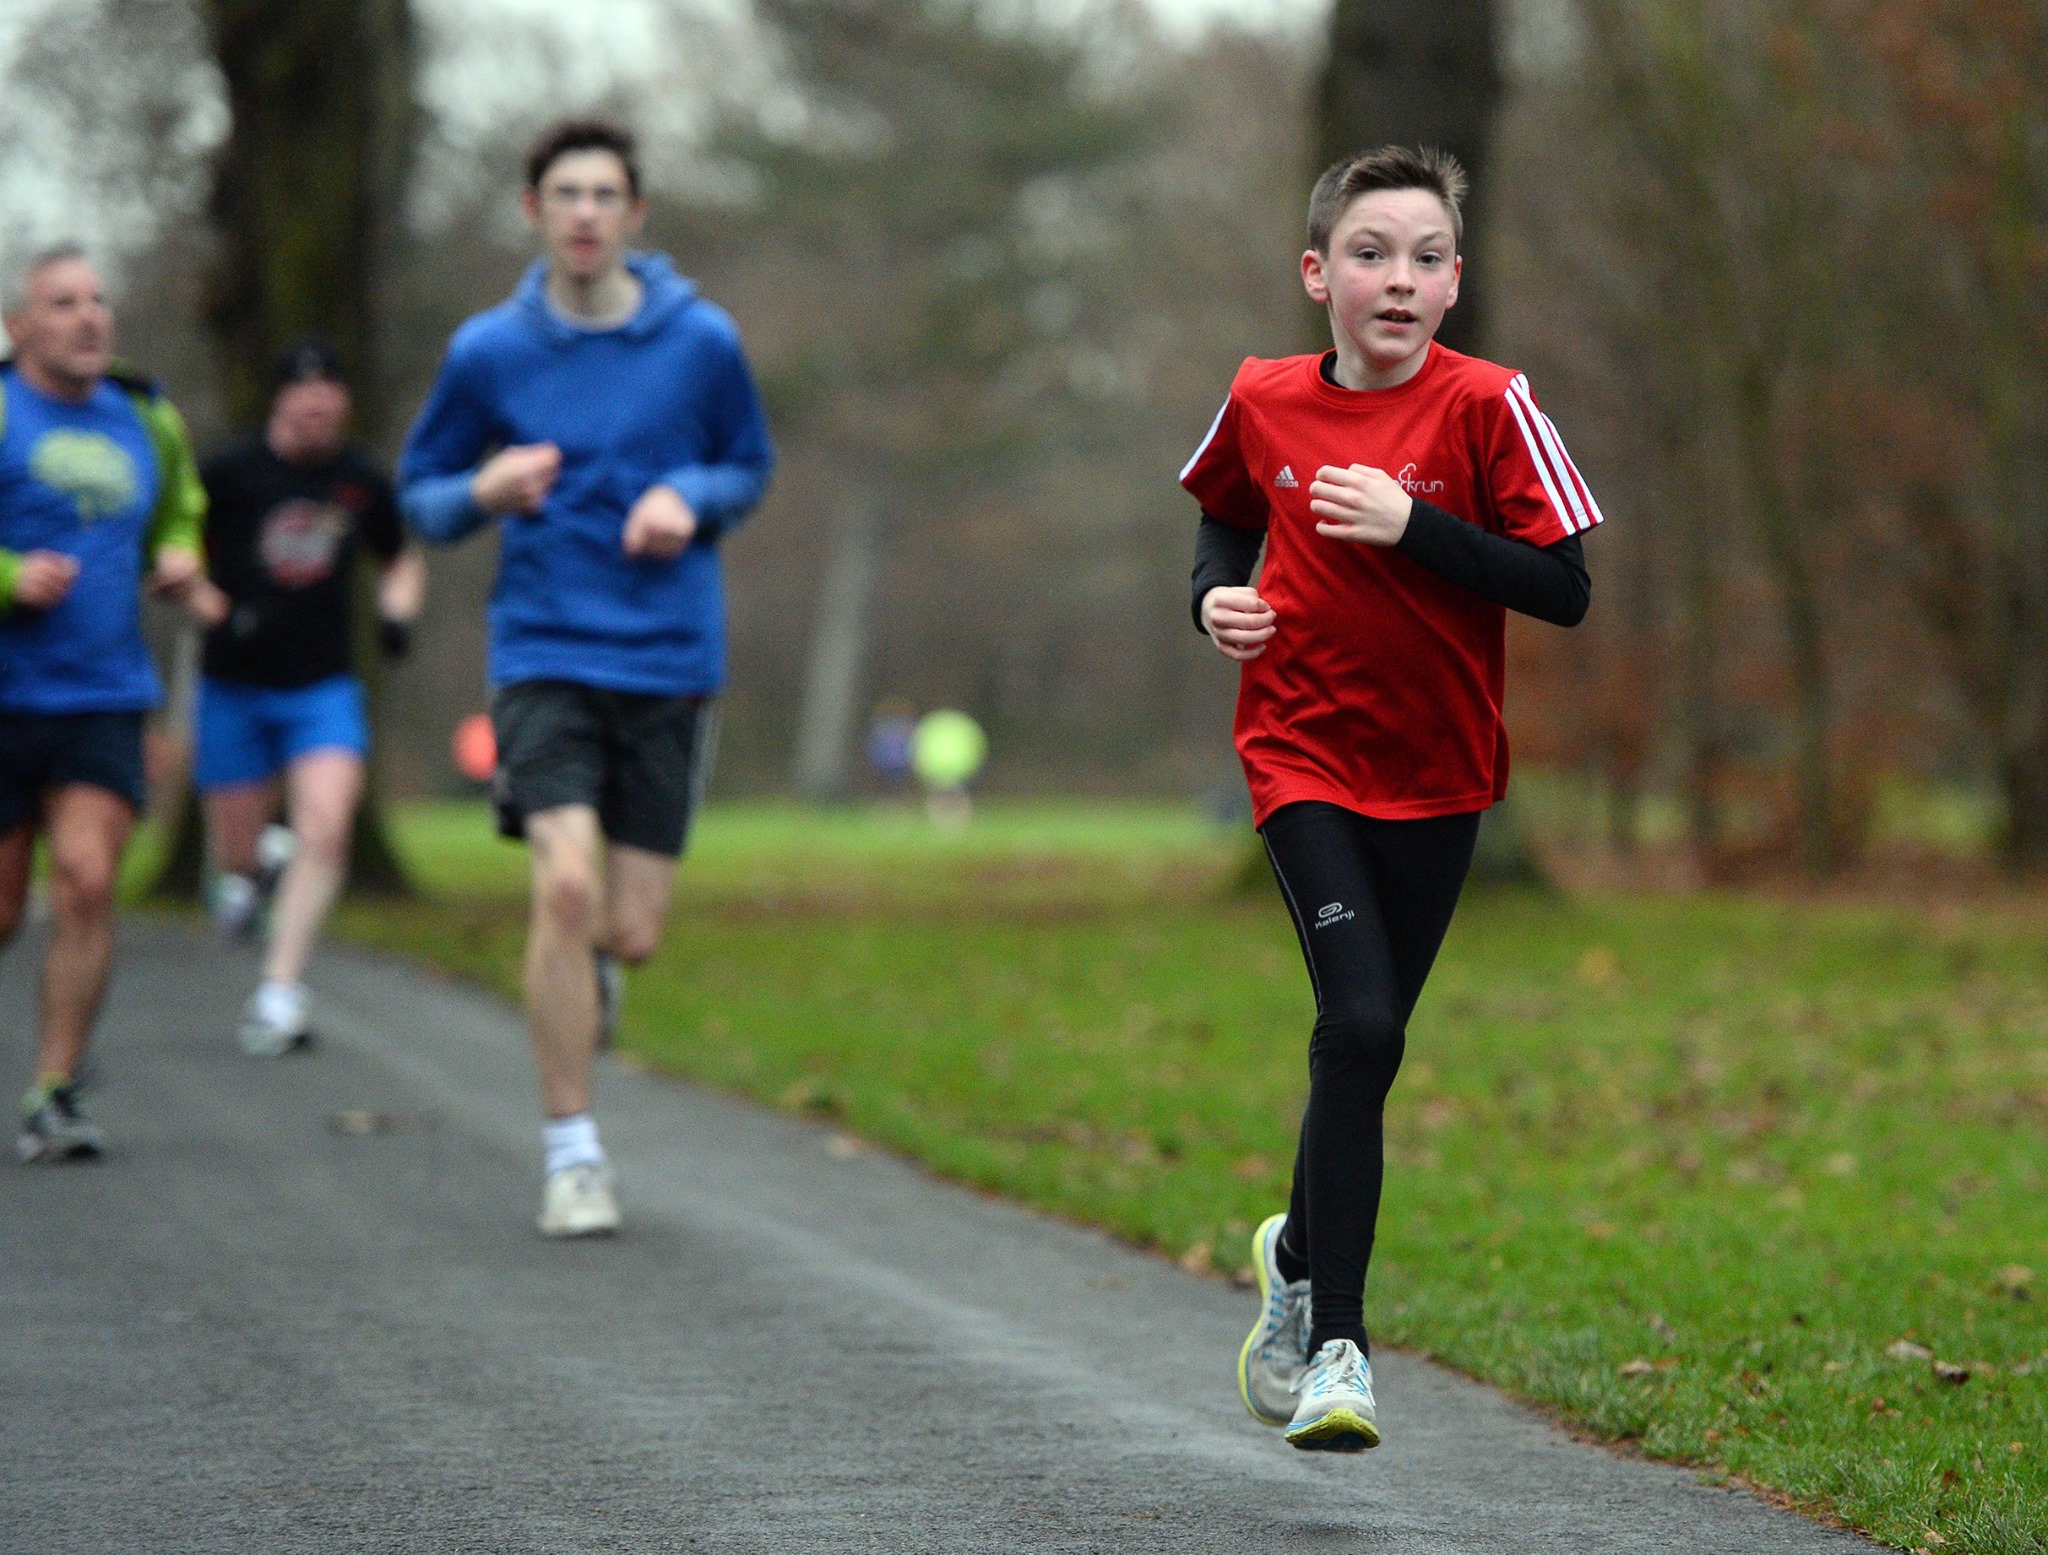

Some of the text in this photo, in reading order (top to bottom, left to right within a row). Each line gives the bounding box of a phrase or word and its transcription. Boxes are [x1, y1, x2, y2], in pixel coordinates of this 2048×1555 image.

[1274, 479, 1299, 488] adidas
[1394, 472, 1444, 493] rkrun
[1314, 909, 1355, 930] Kalenji
